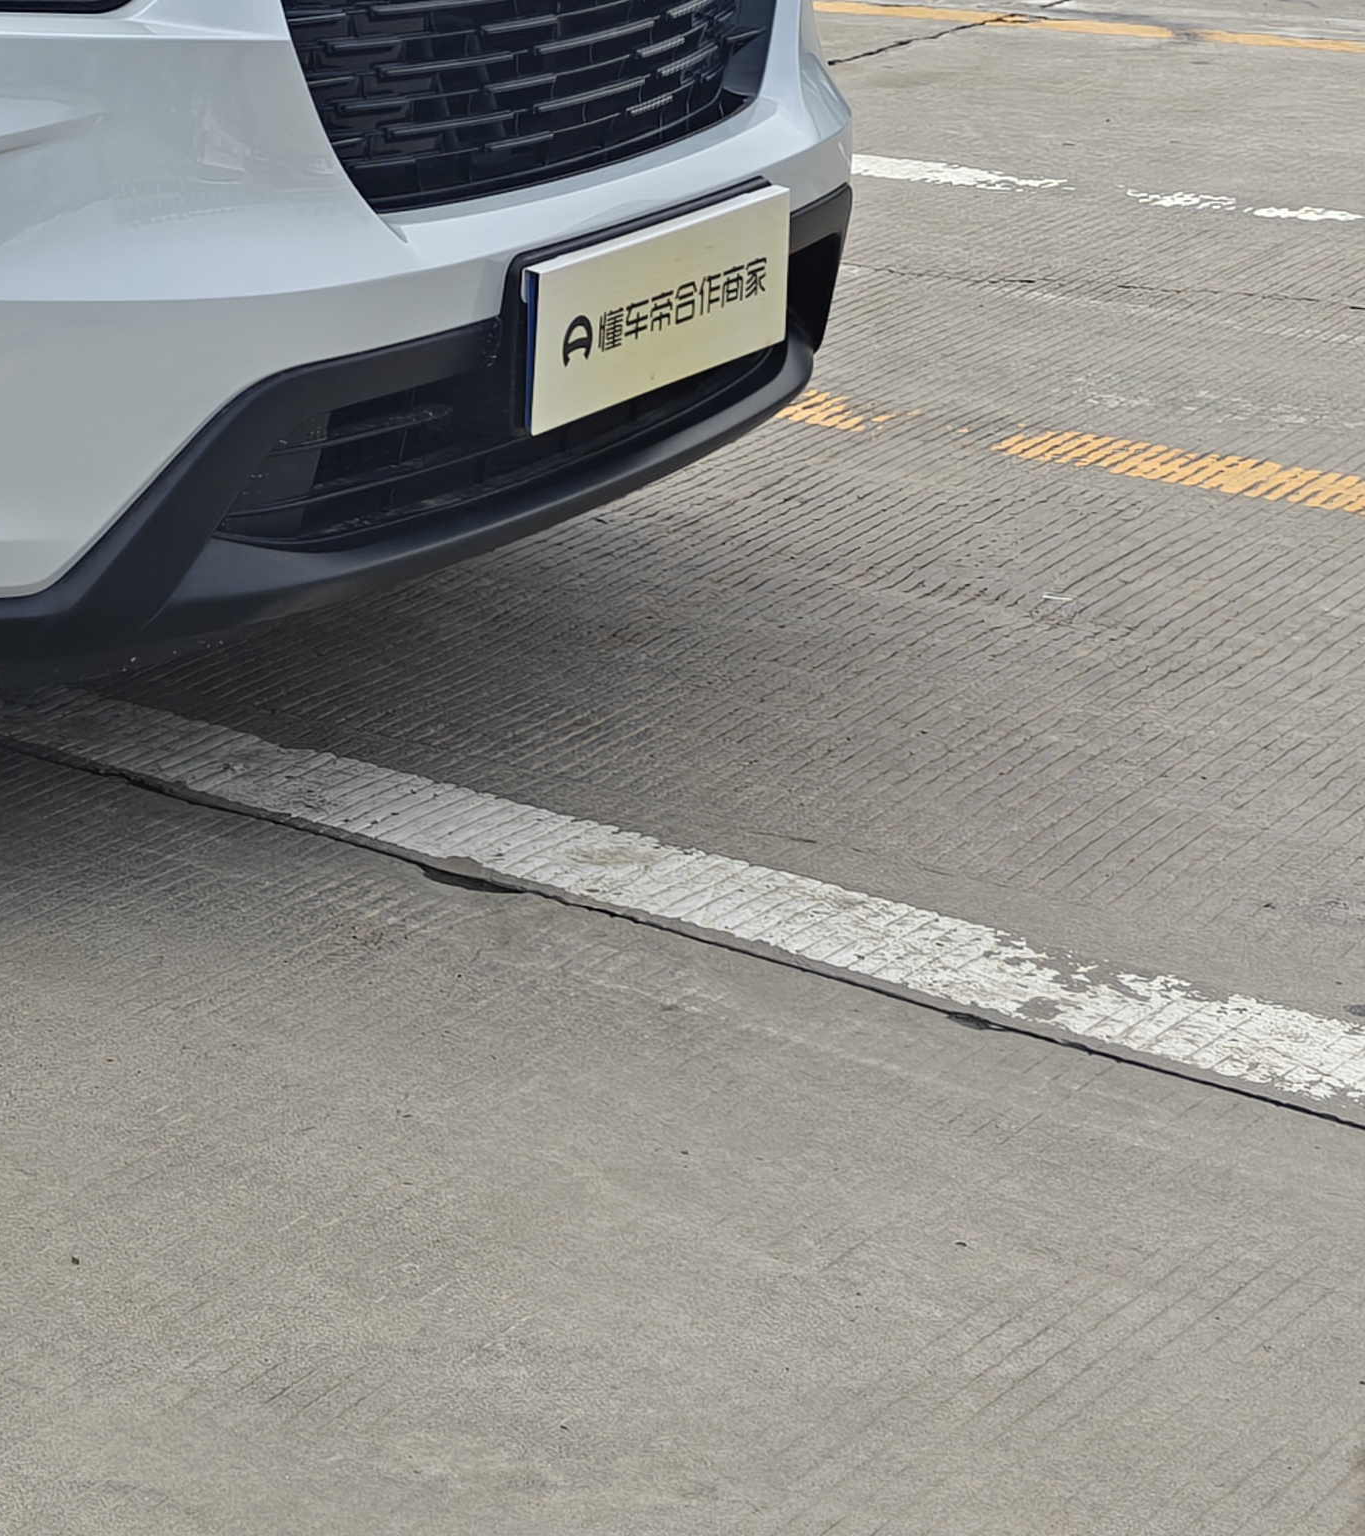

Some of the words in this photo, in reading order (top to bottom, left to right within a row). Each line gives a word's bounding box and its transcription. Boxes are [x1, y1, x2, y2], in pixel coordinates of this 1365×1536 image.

[597, 257, 768, 353] 懂车帝合作商家
